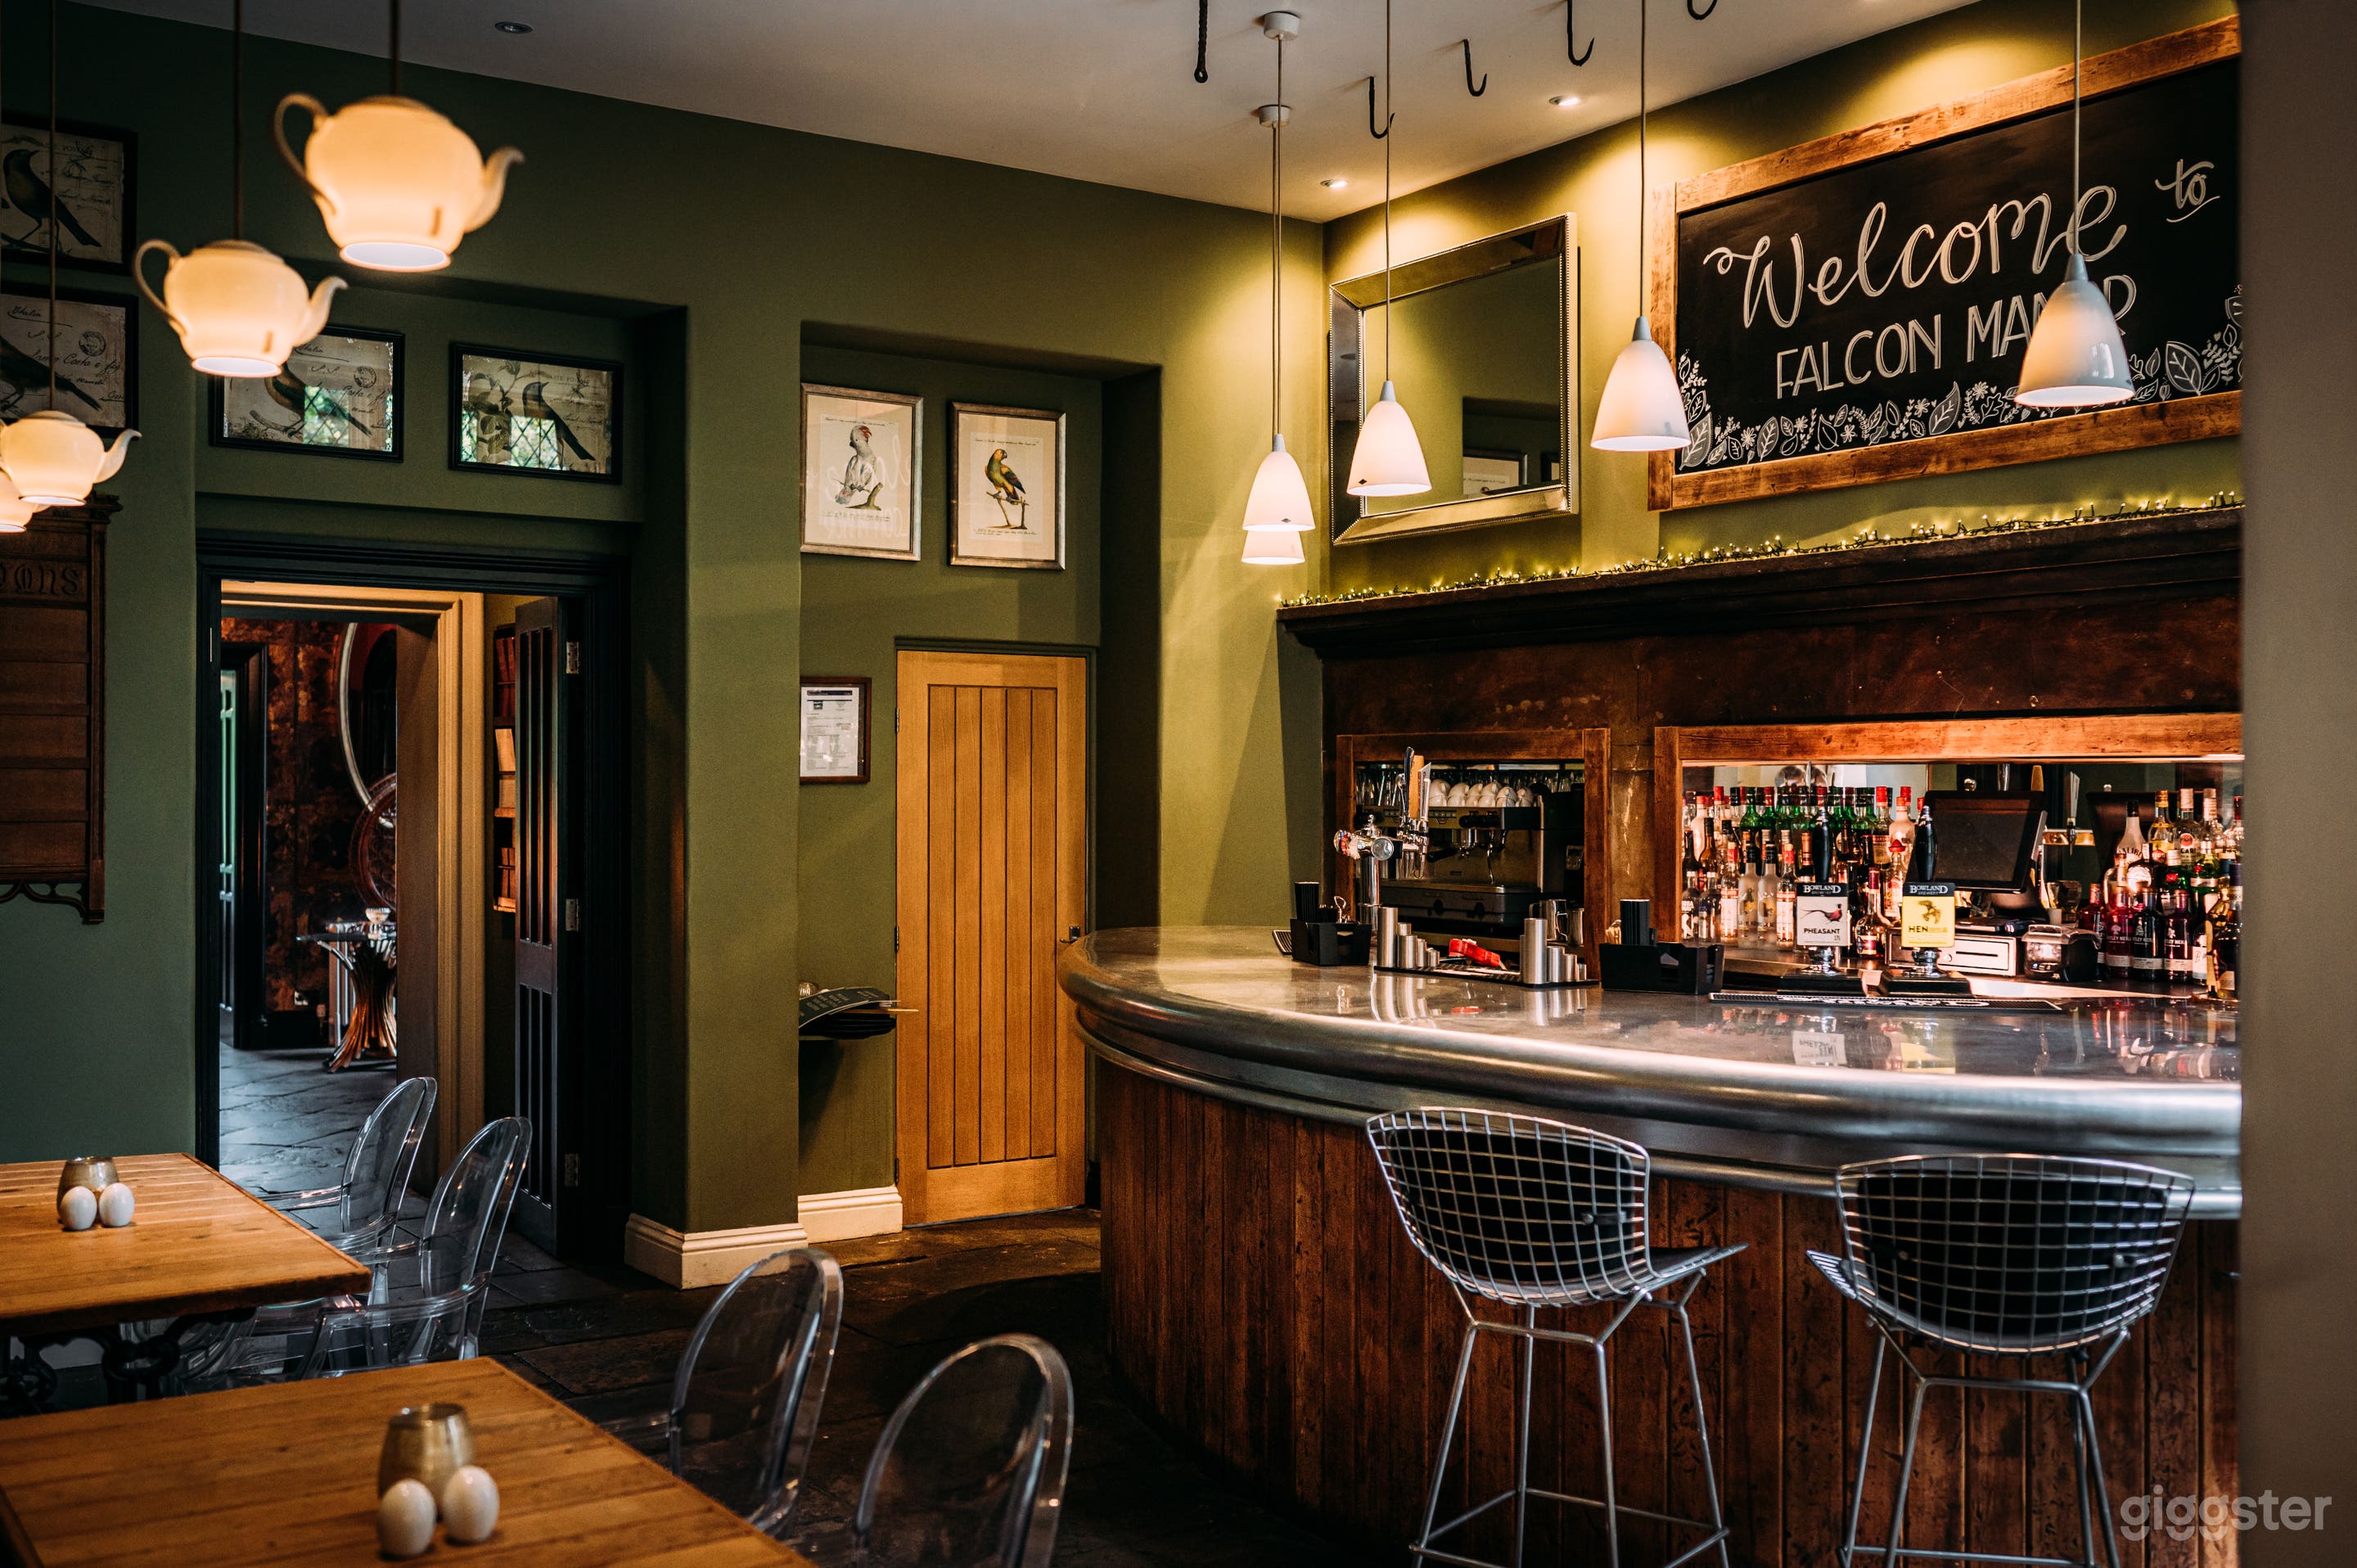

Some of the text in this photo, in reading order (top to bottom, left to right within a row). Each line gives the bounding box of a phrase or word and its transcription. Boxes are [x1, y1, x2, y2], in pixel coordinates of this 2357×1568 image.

[1703, 159, 2217, 329] Welcome to
[1777, 275, 2137, 399] FALCON MANR
[1803, 885, 1841, 894] BOWLAND
[1909, 885, 1949, 894] BOWLAND
